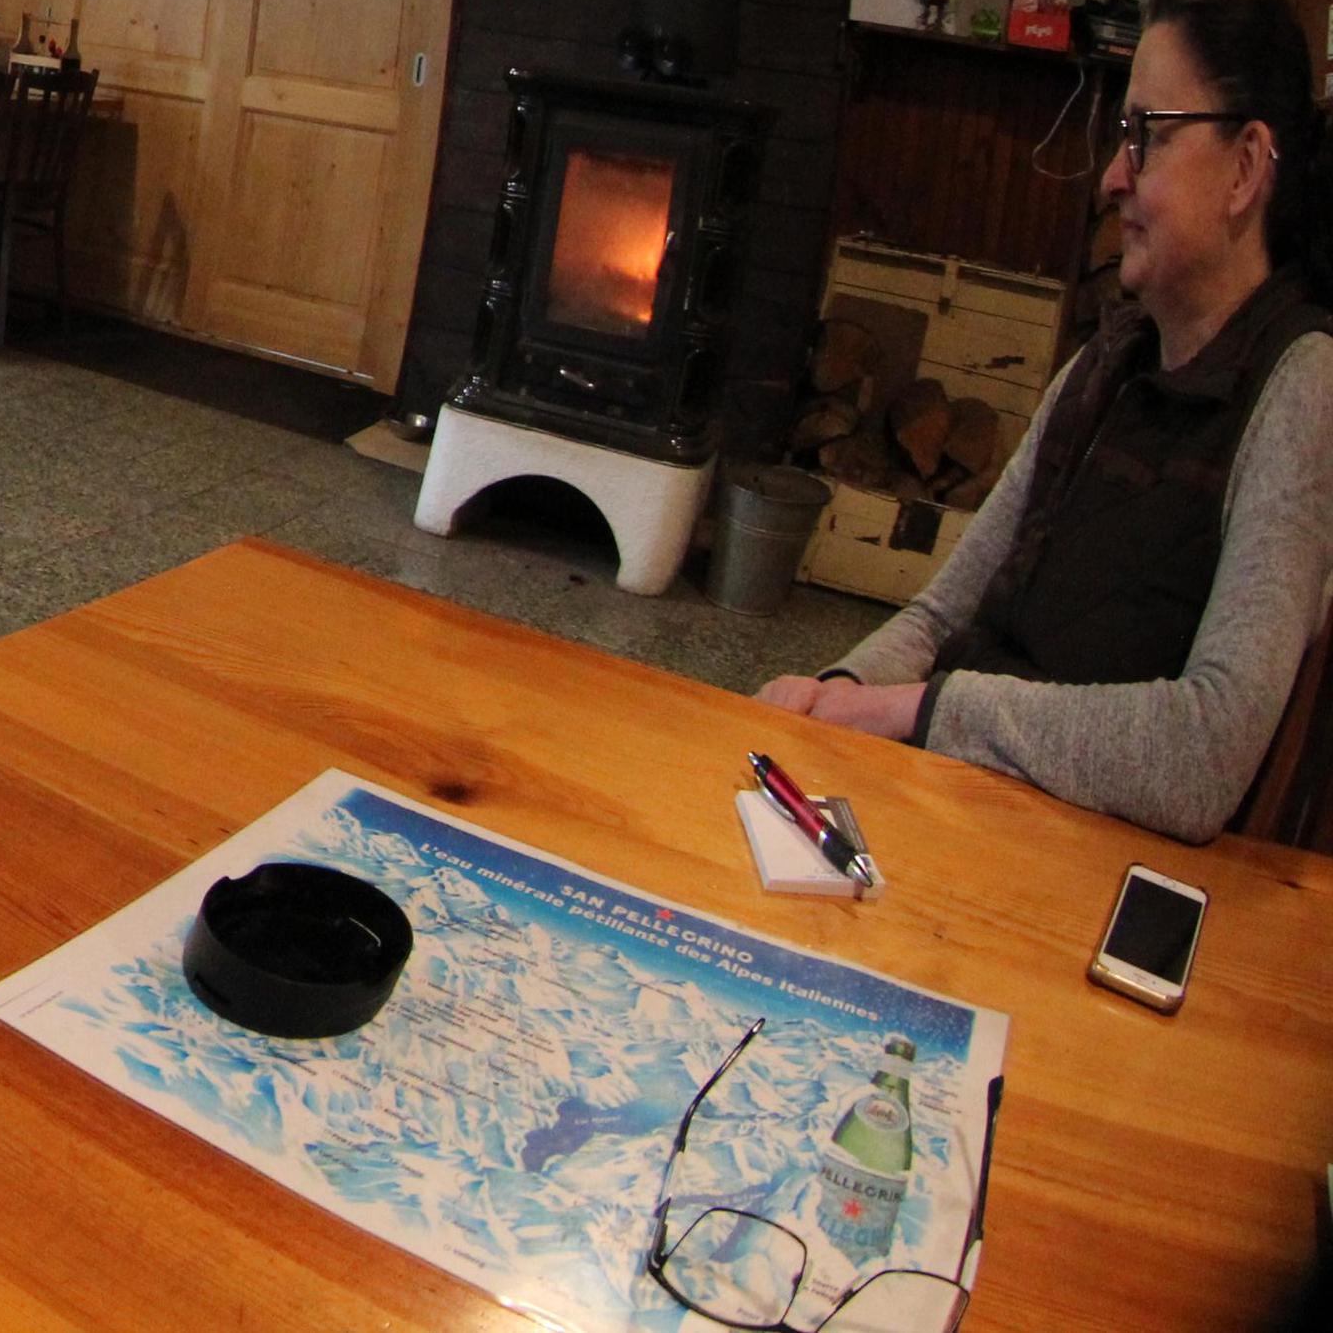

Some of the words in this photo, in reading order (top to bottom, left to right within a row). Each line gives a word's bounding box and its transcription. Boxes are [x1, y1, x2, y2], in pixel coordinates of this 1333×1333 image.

[419, 842, 474, 872] L'eau
[475, 863, 565, 909] minérale
[567, 903, 671, 949] pétillante
[674, 941, 713, 968] des
[714, 955, 773, 990] Alpes
[777, 977, 881, 1023] italiennes
[559, 883, 607, 913] SAN
[609, 903, 755, 965] PELLEGRINO
